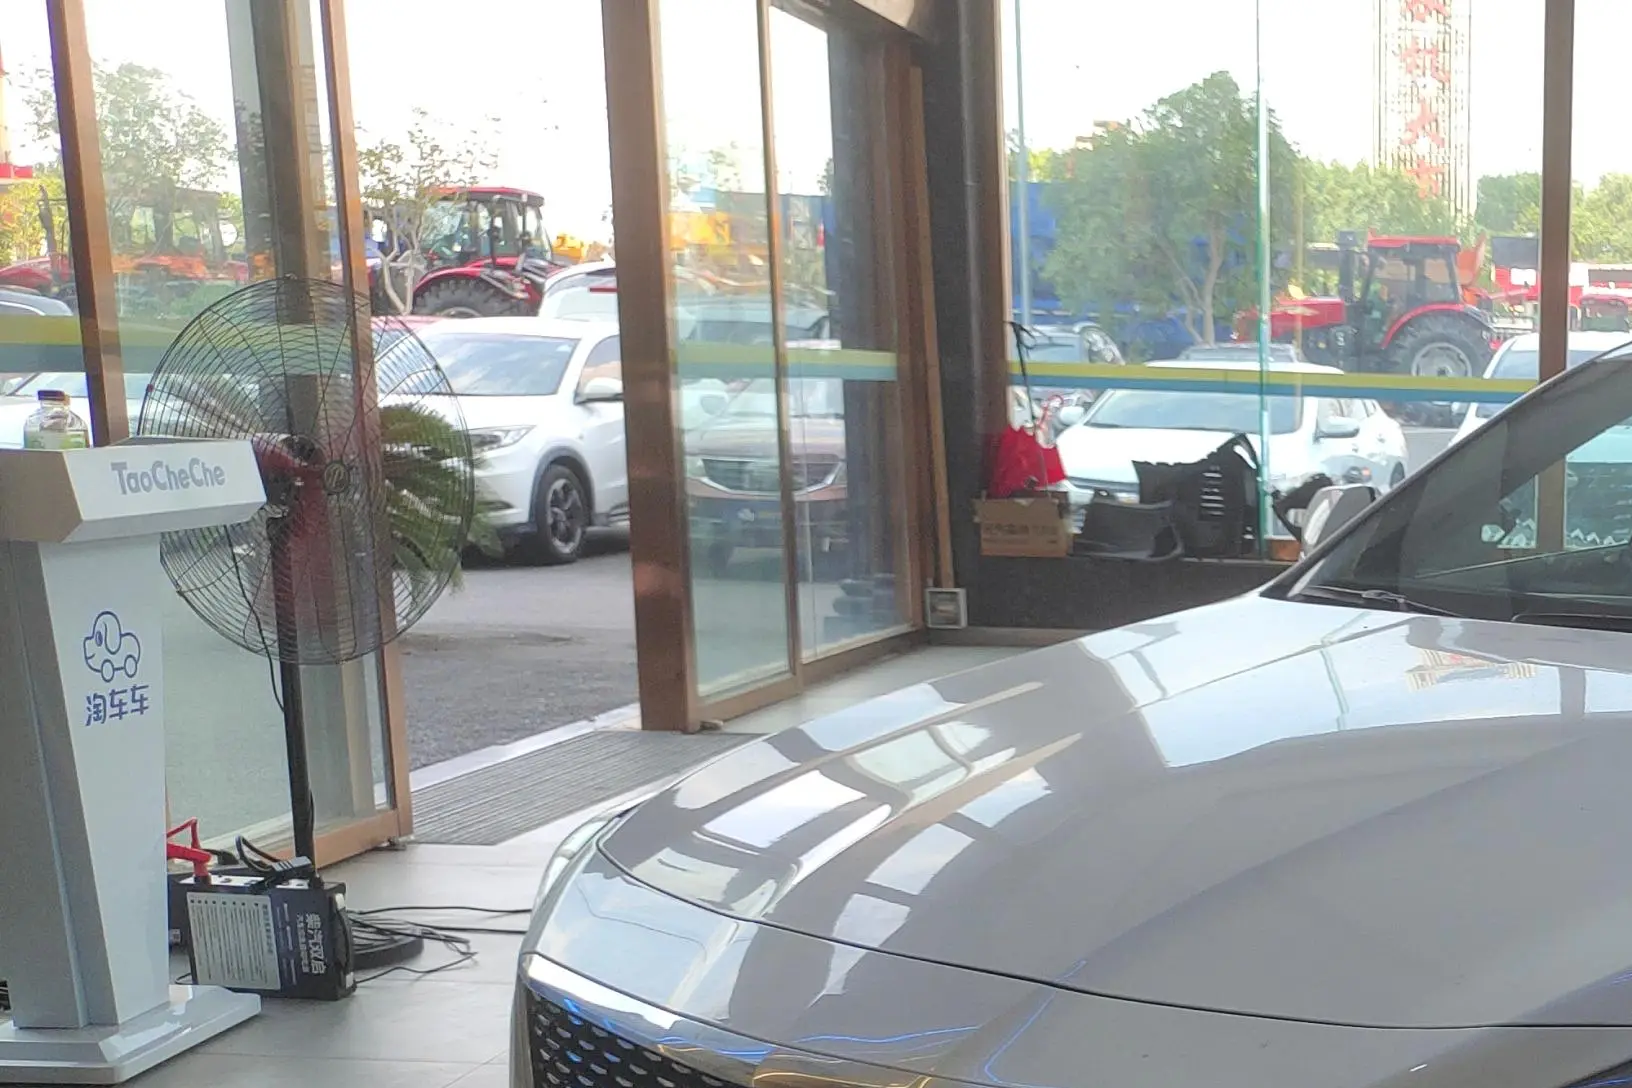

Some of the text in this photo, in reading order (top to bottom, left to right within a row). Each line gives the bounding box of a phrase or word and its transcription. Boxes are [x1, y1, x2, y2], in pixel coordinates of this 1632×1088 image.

[110, 457, 225, 495] TaoCheChe
[85, 684, 149, 727] 淘车车
